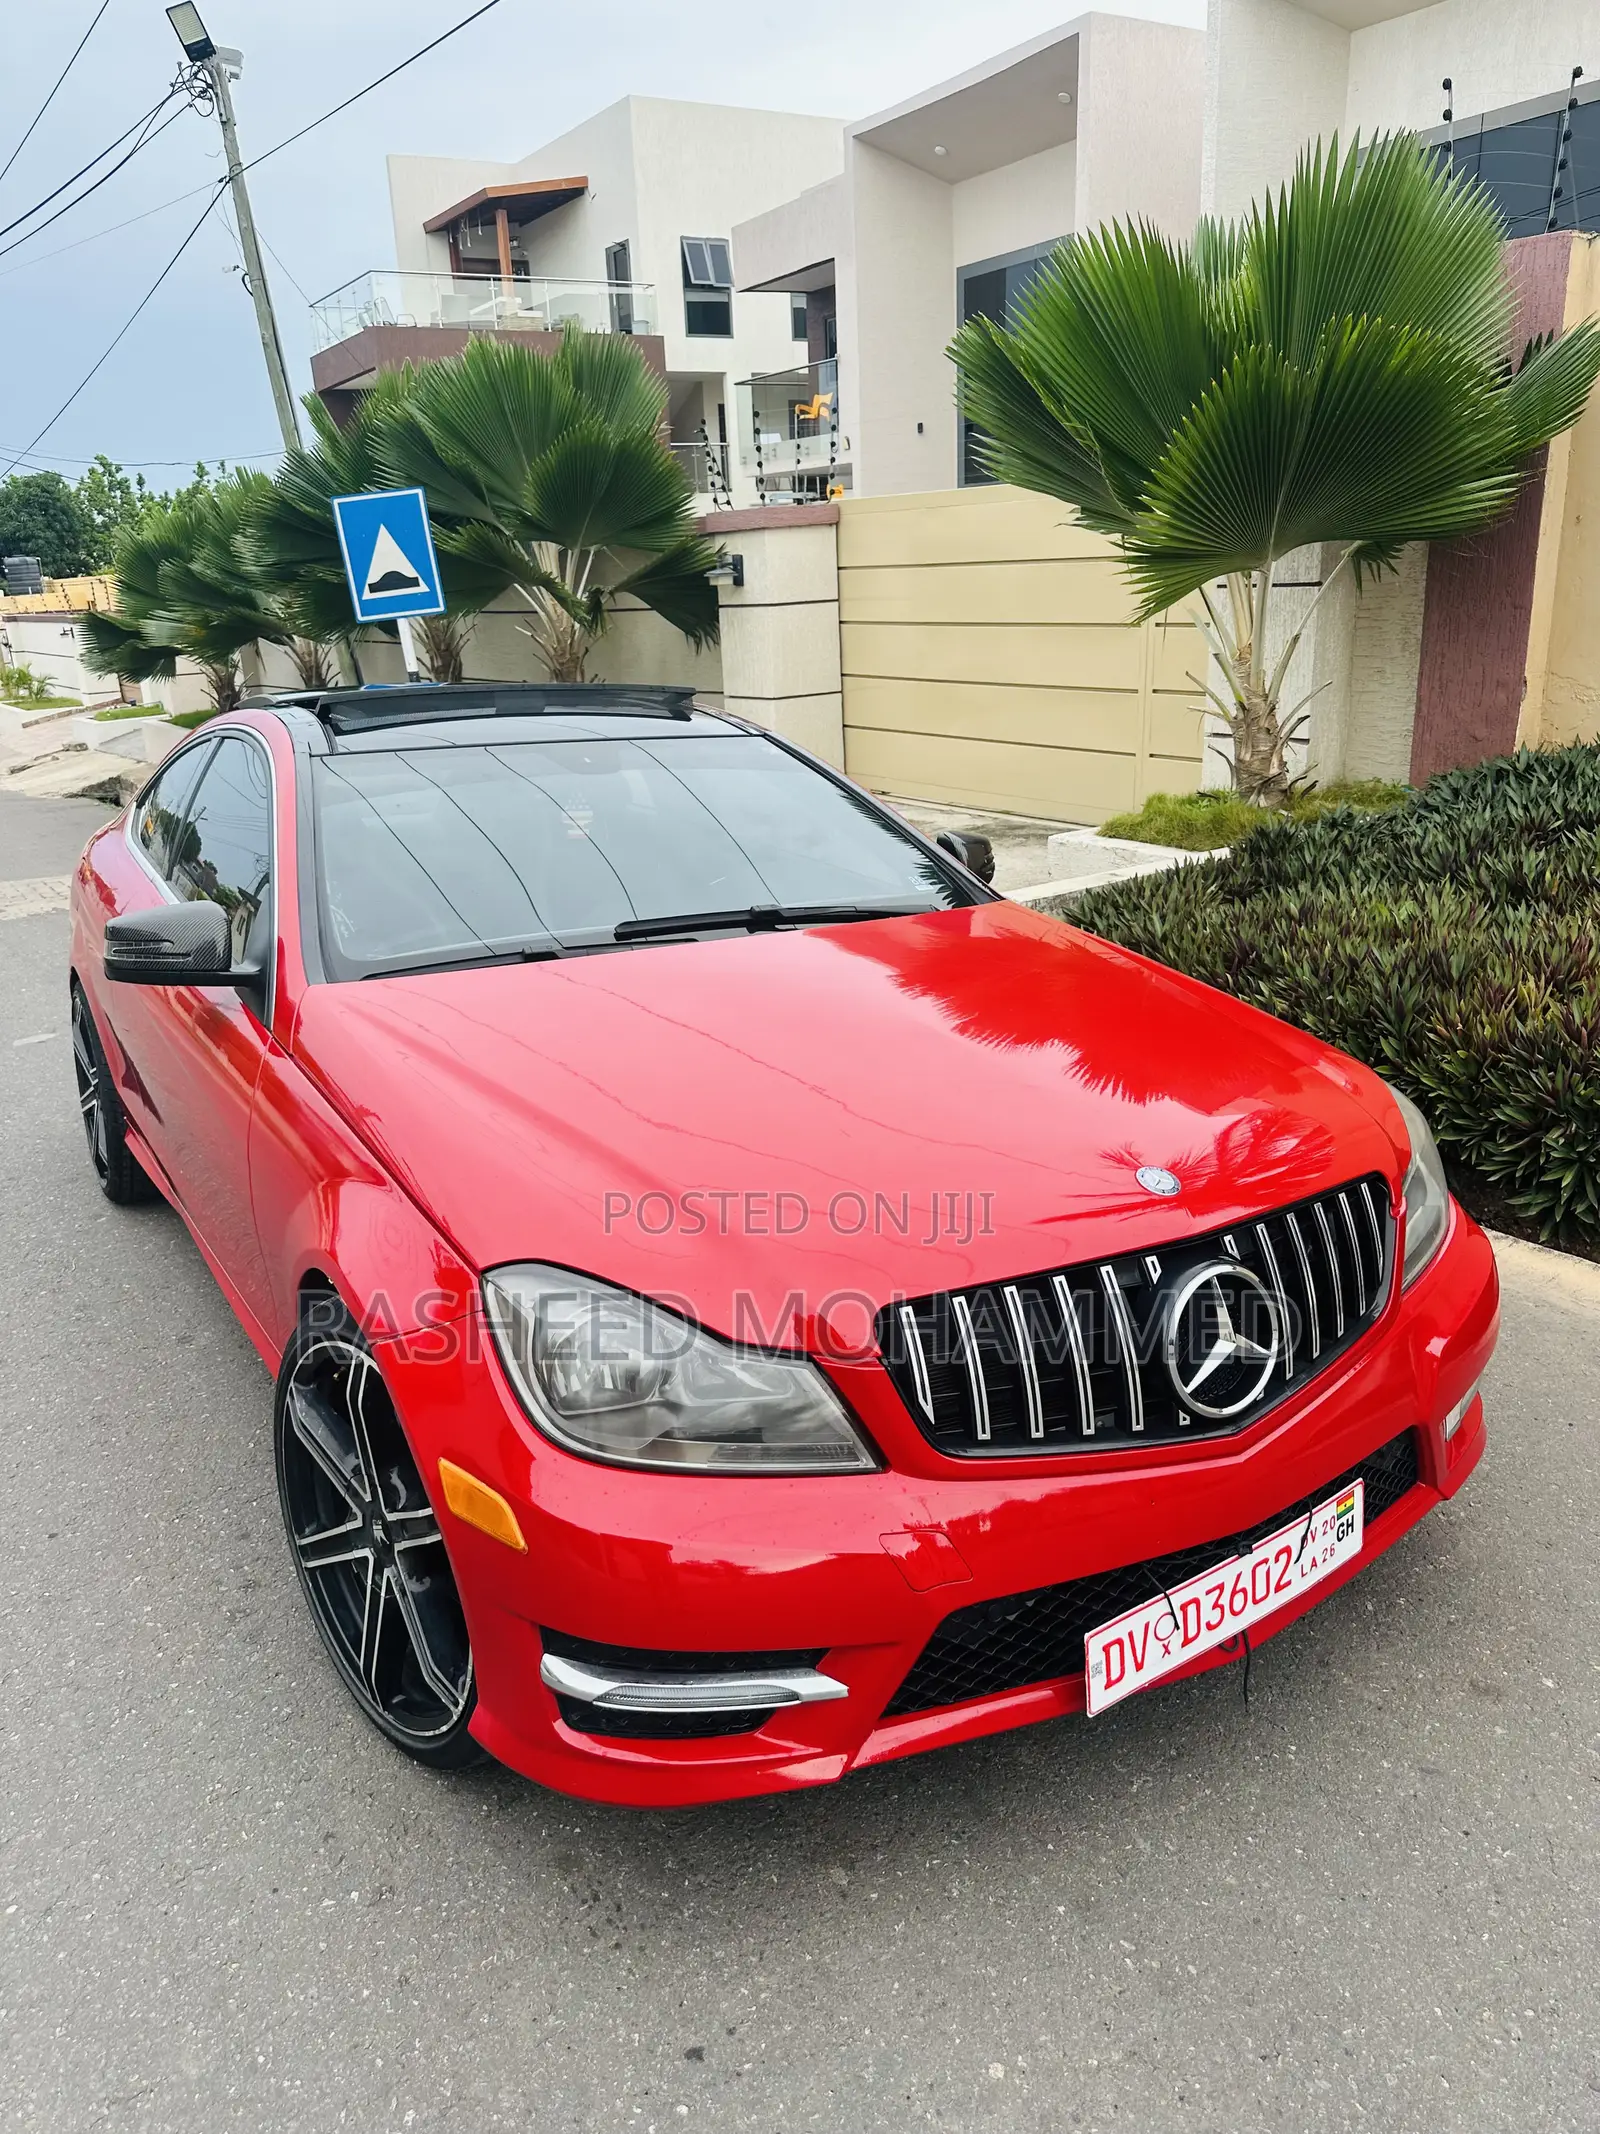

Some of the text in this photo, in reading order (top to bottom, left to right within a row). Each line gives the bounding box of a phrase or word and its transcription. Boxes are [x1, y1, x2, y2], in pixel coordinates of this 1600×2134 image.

[1336, 1514, 1354, 1542] GH
[1300, 1543, 1336, 1578] LA 26
[1102, 1620, 1150, 1690] DV
[1180, 1545, 1293, 1649] D3602
